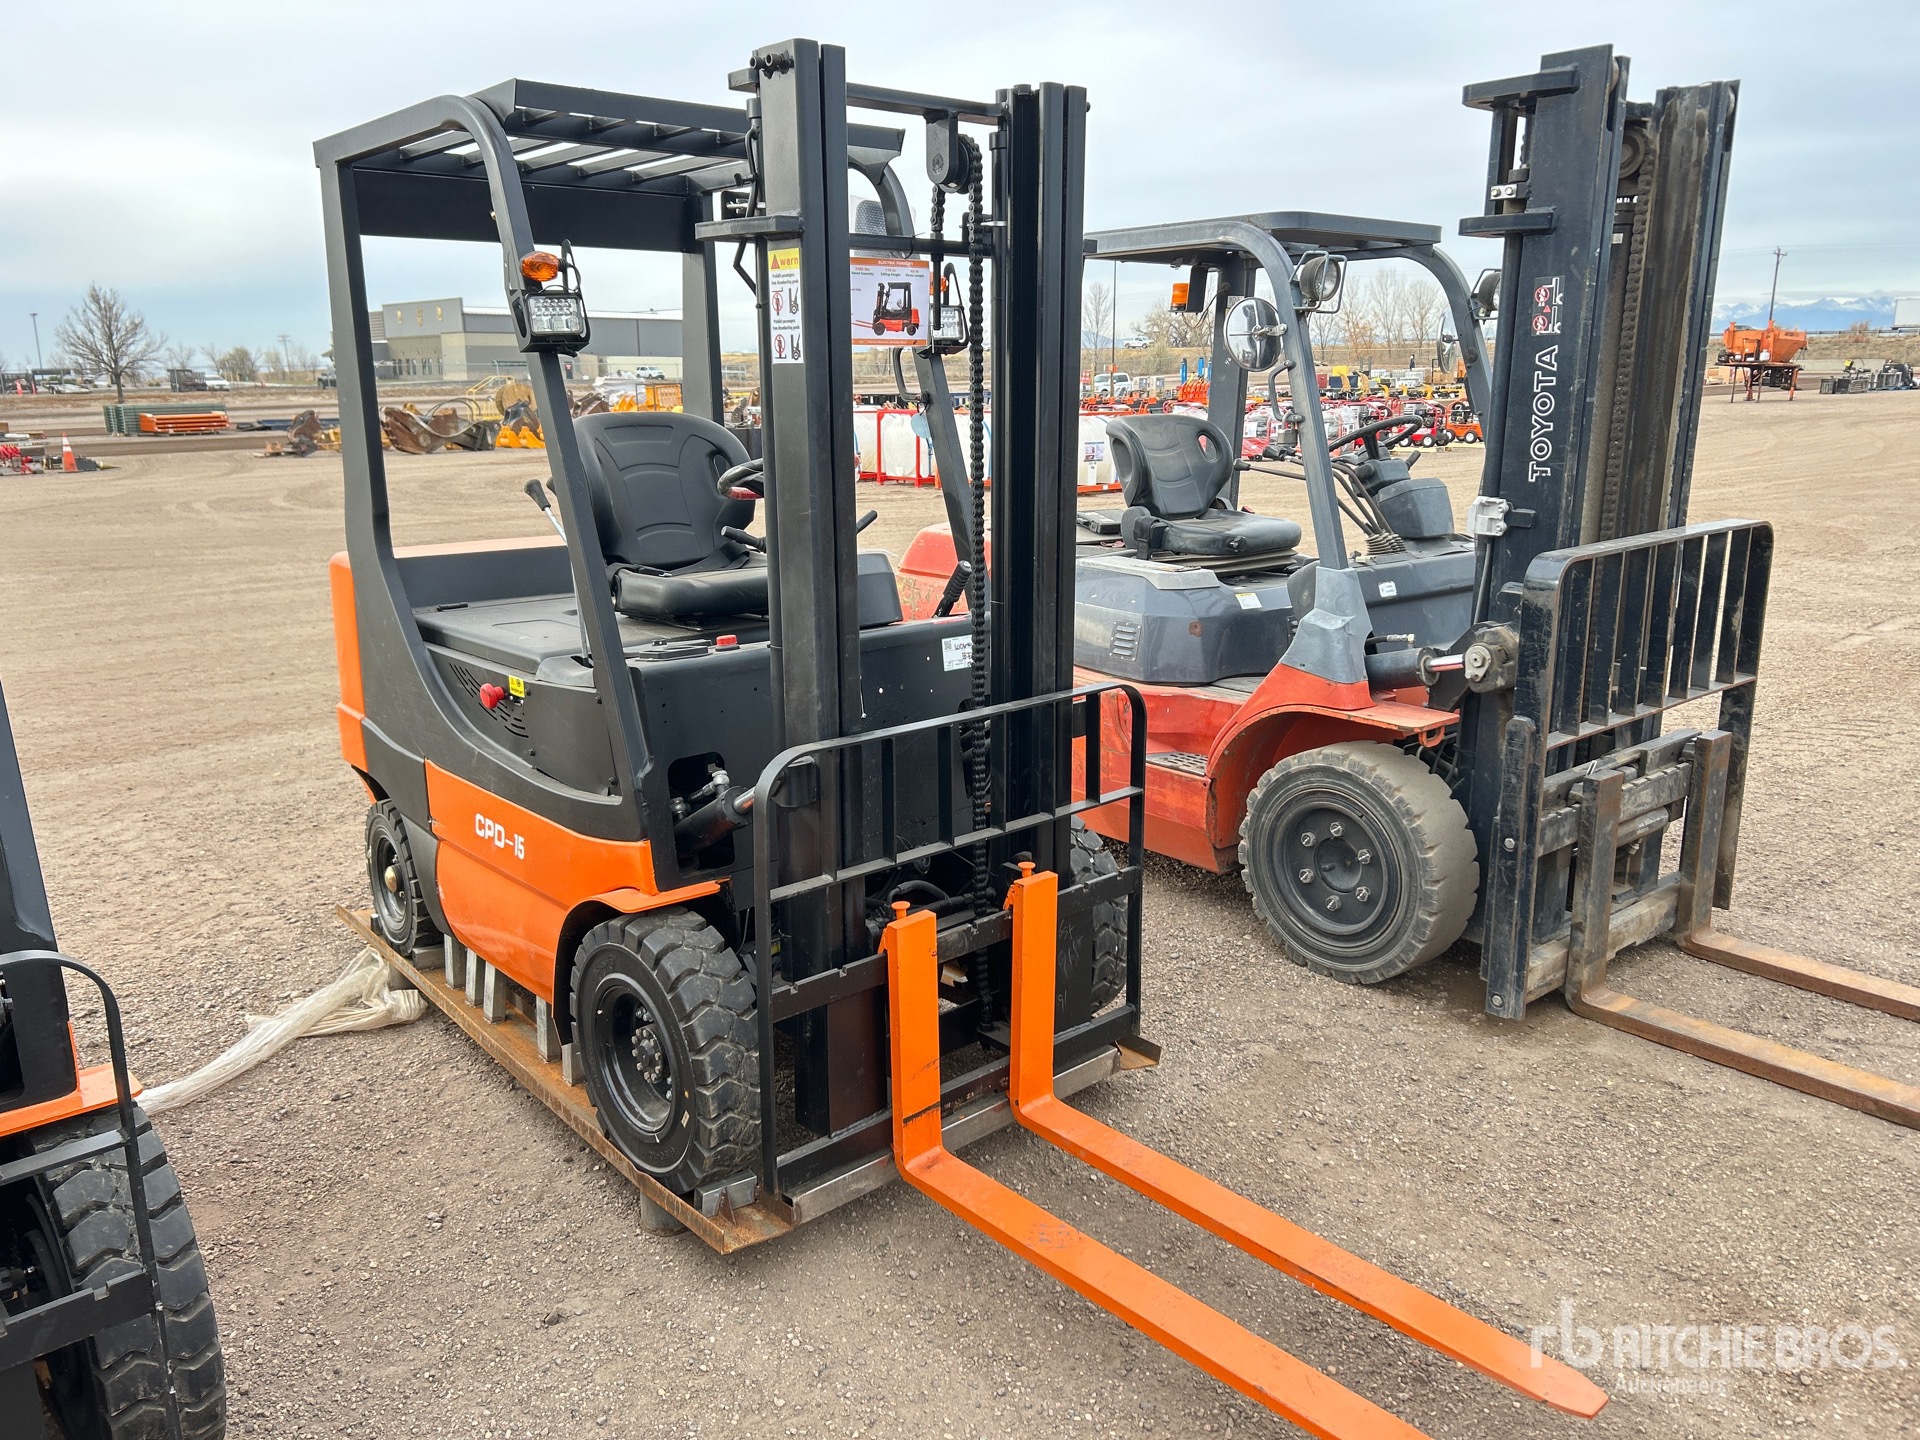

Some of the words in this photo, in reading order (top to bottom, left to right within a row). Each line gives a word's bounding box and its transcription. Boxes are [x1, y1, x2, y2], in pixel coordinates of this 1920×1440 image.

[779, 257, 799, 266] warn
[1528, 344, 1559, 483] TOYOTA
[475, 813, 525, 860] CPD-15
